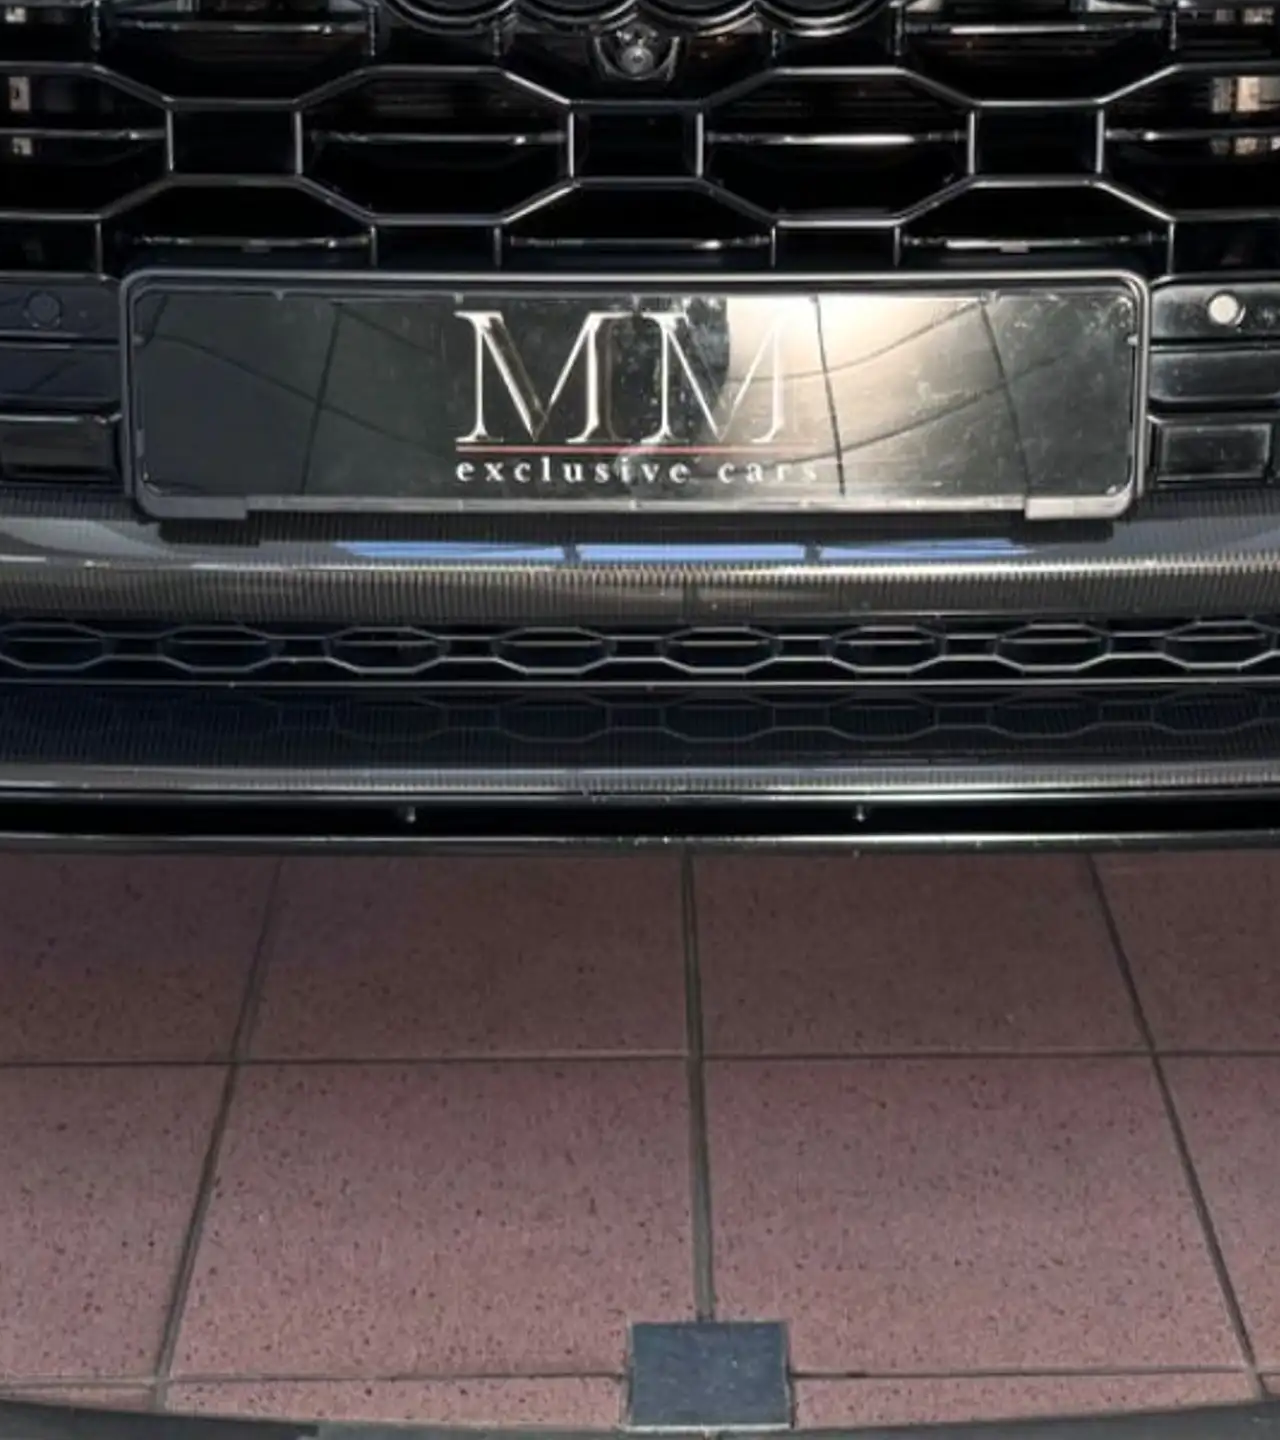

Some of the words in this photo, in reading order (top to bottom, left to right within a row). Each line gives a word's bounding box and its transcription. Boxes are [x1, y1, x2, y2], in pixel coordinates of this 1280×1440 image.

[454, 311, 821, 443] MM
[455, 457, 692, 485] exclusive
[717, 459, 819, 484] cars
